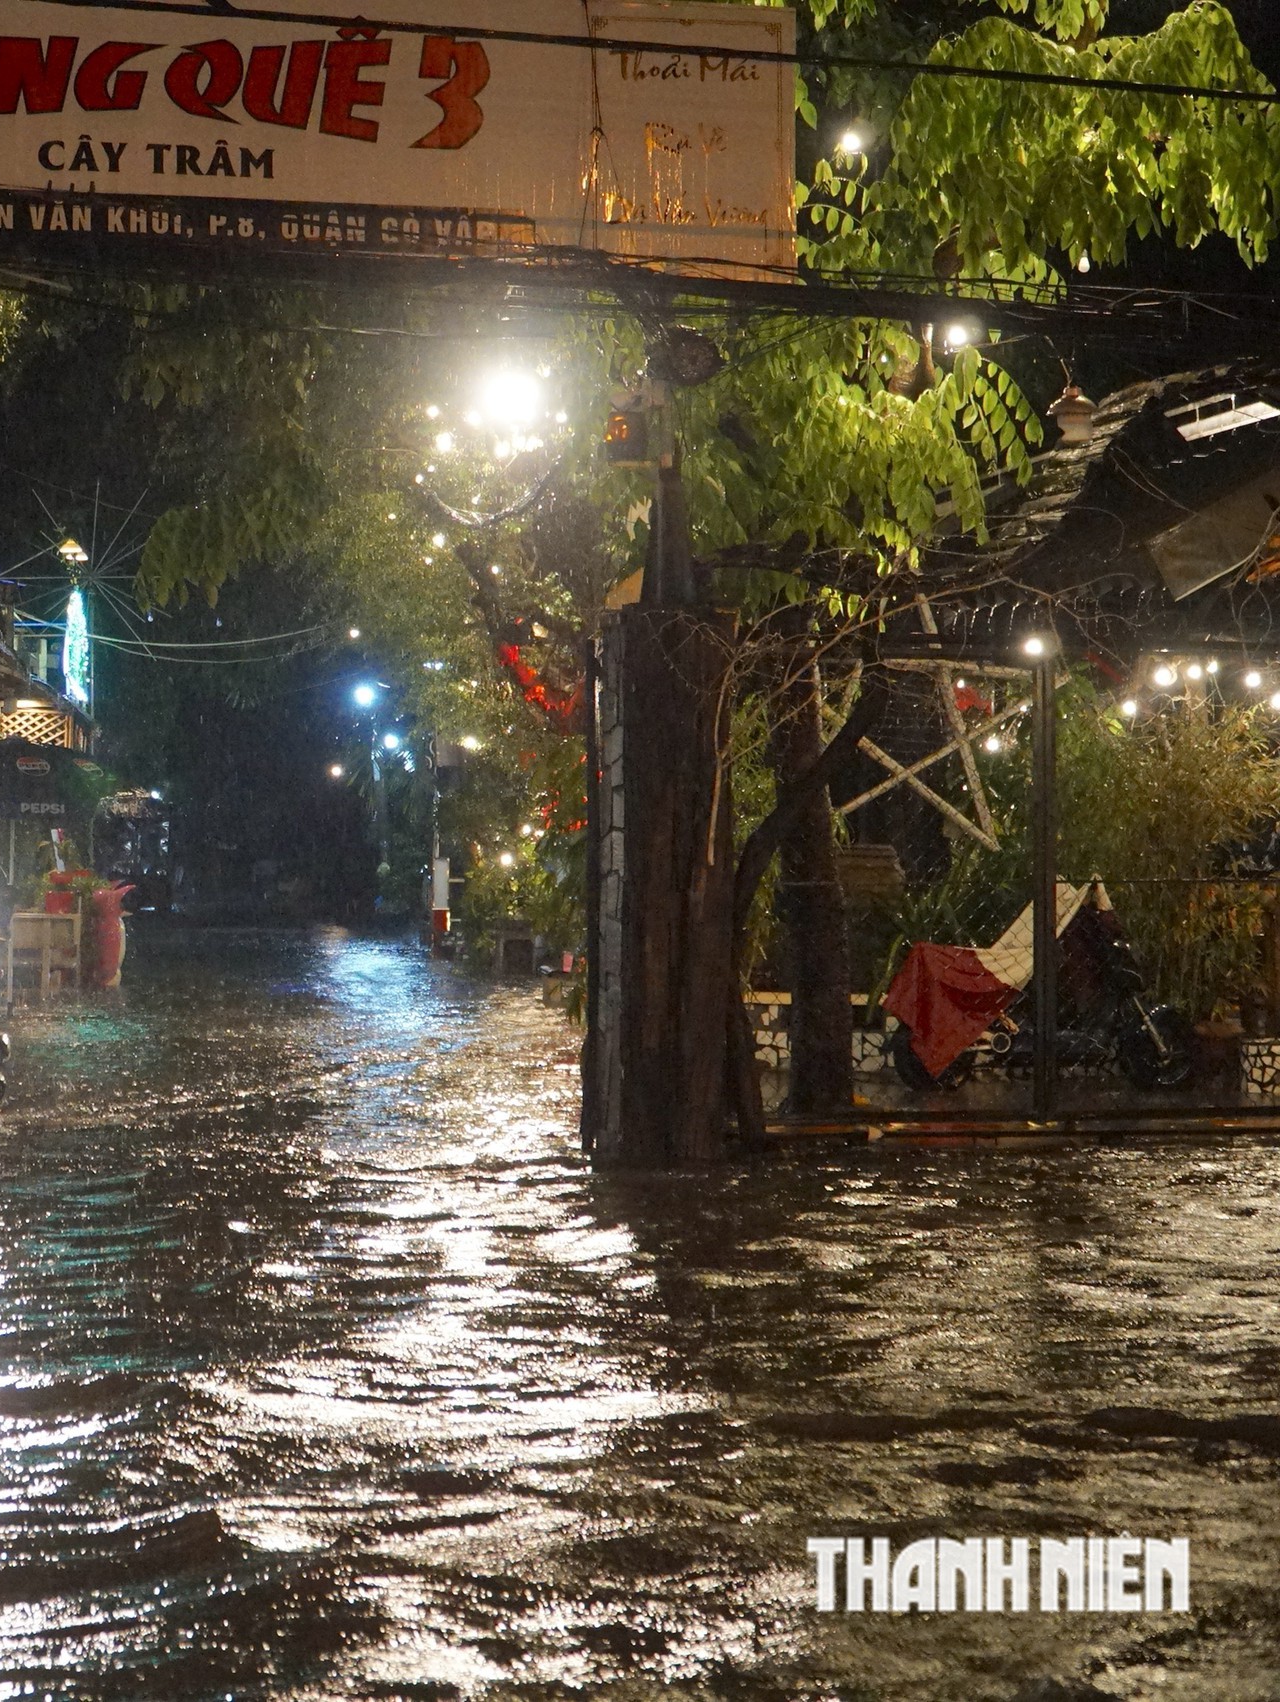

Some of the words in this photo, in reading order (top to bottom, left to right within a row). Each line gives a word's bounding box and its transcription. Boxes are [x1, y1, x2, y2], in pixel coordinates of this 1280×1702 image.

[164, 15, 392, 143] QUÊ
[408, 35, 491, 149] 3
[609, 50, 690, 82] Thoải
[699, 56, 761, 82] Mái
[38, 134, 128, 172] CÂY
[146, 139, 275, 179] TRÂM
[29, 200, 92, 232] VĂN
[281, 210, 366, 246] QUẬN
[20, 802, 65, 815] PEPSI
